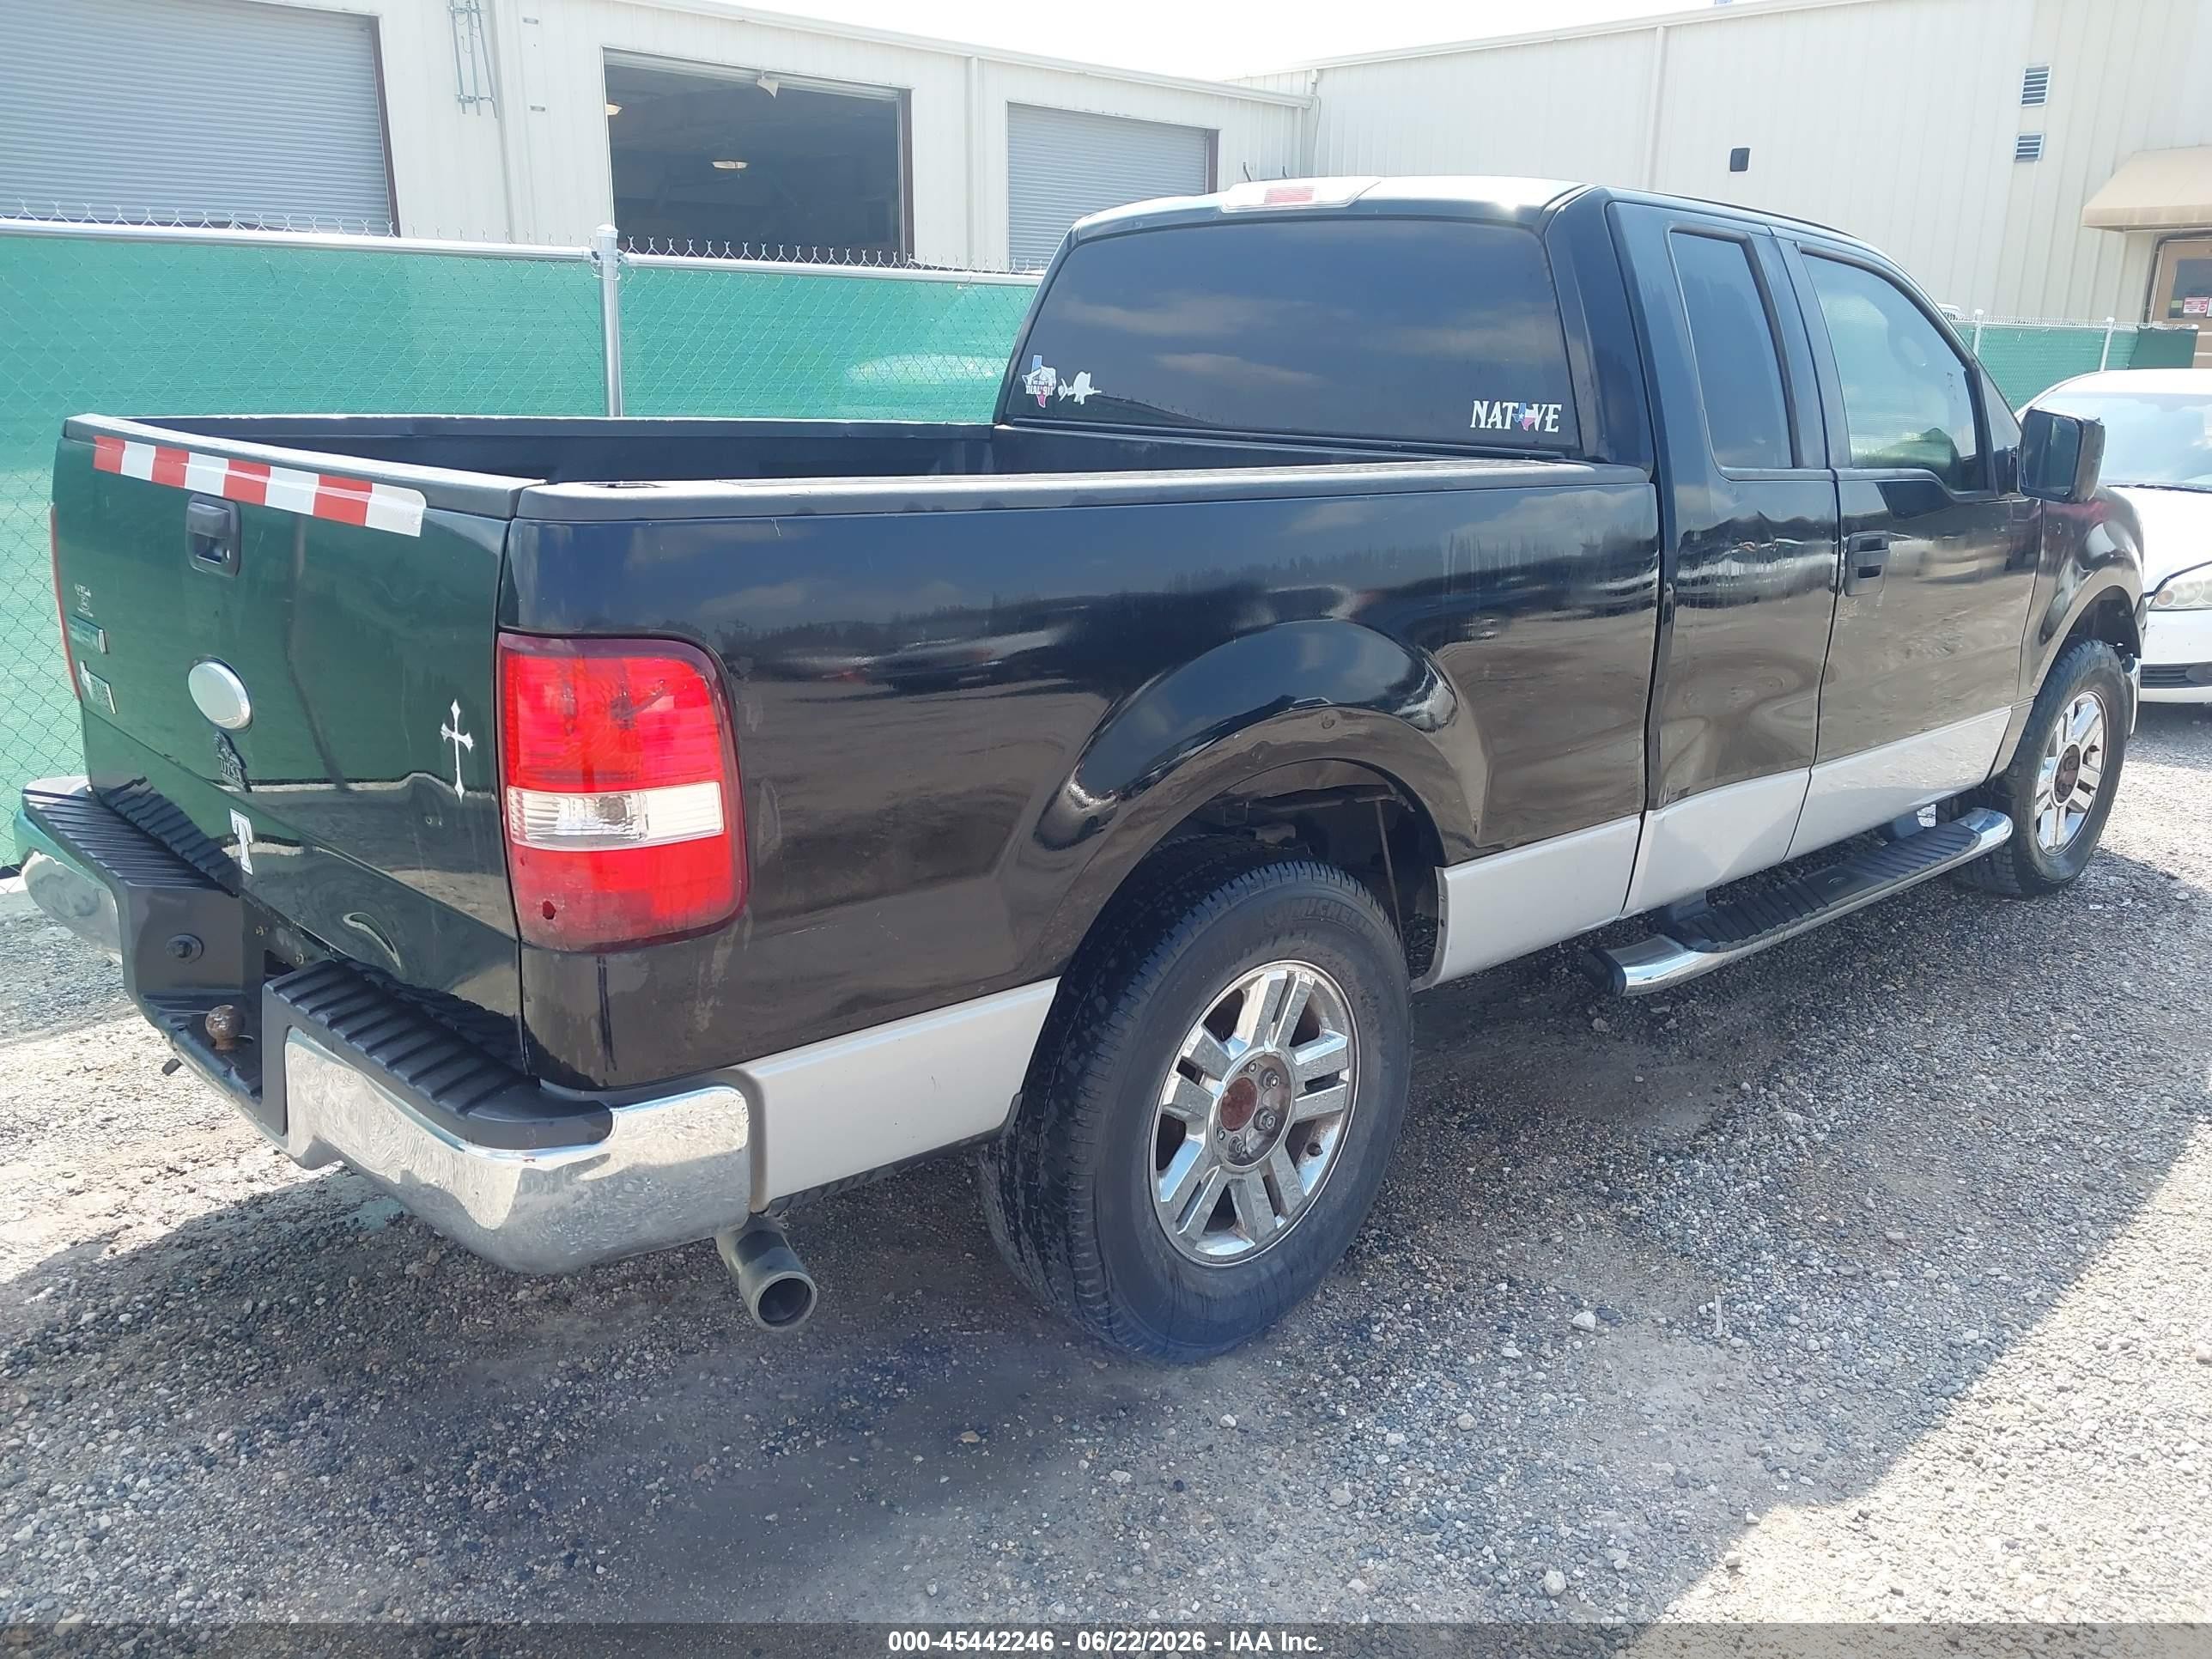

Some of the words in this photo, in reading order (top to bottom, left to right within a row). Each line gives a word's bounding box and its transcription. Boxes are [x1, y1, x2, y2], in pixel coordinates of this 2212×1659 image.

[1025, 385, 1041, 394] DIAL
[1042, 386, 1053, 395] 911
[1469, 400, 1562, 433] NATVE
[219, 758, 243, 784] UTSA
[229, 808, 253, 875] T
